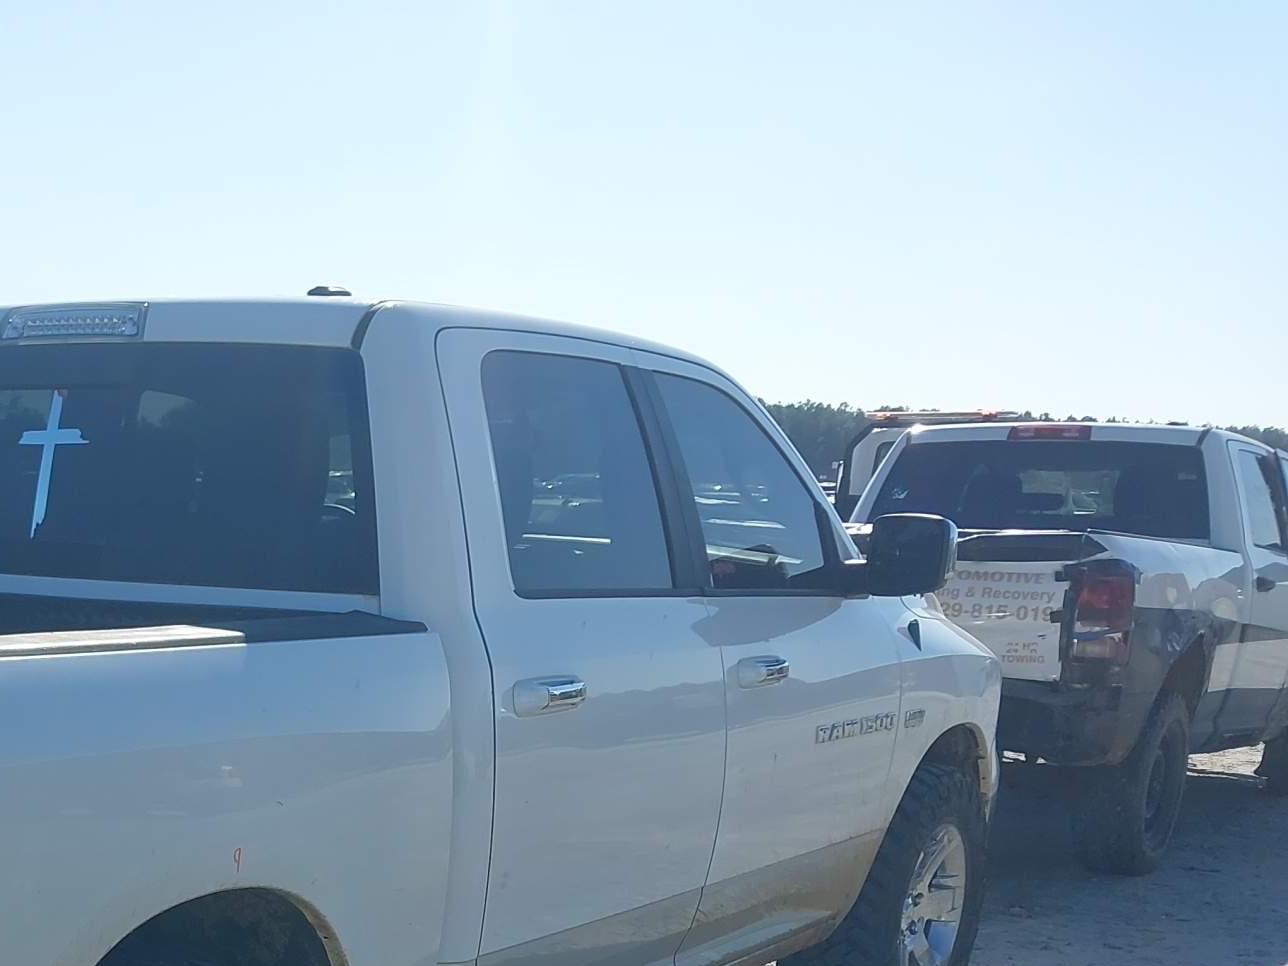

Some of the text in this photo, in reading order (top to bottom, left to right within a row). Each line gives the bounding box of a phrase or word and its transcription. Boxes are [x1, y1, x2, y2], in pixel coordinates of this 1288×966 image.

[981, 586, 1057, 604] Recovery
[1000, 654, 1046, 665] TOWING
[815, 719, 859, 744] RAM
